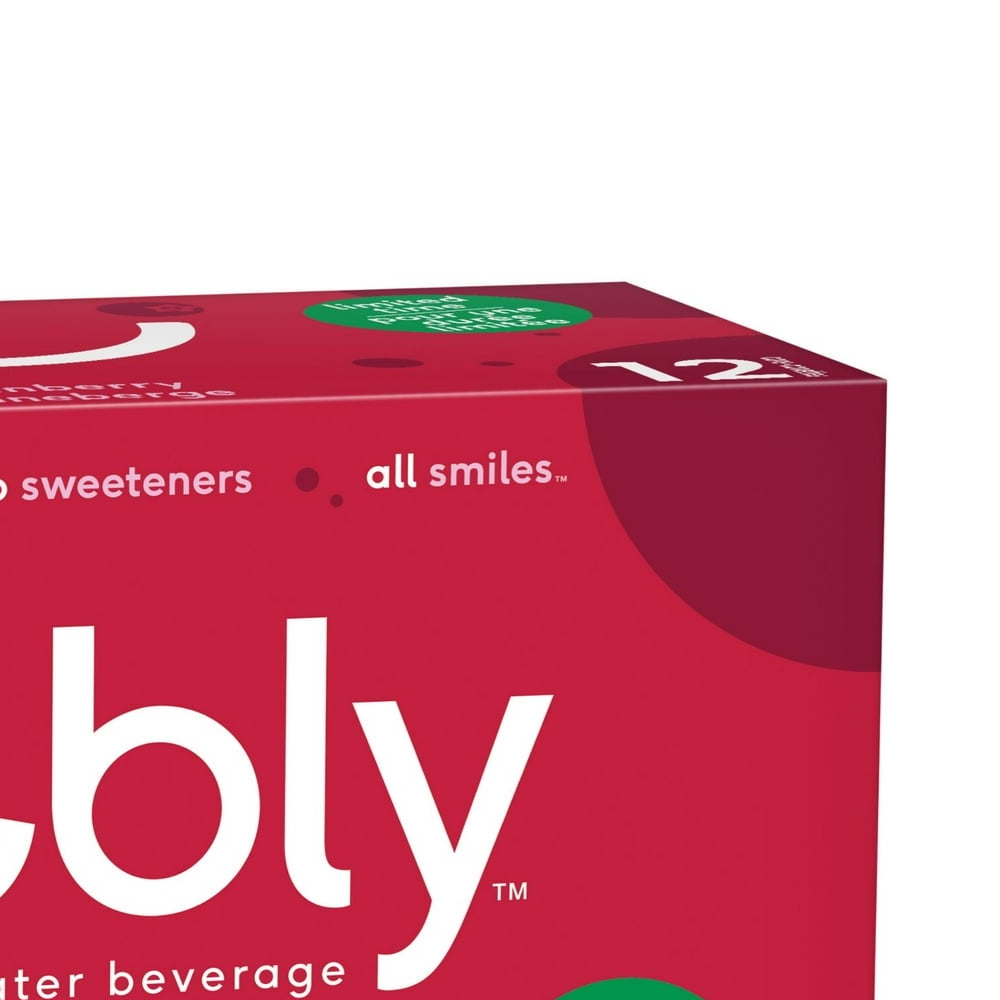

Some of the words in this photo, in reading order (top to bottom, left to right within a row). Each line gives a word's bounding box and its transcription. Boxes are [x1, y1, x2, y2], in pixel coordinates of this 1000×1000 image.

[322, 295, 469, 311] limited
[590, 358, 794, 382] 12
[21, 466, 252, 501] sweeteners
[366, 453, 417, 489] all
[429, 449, 552, 487] smiles
[109, 959, 345, 1000] beverage
